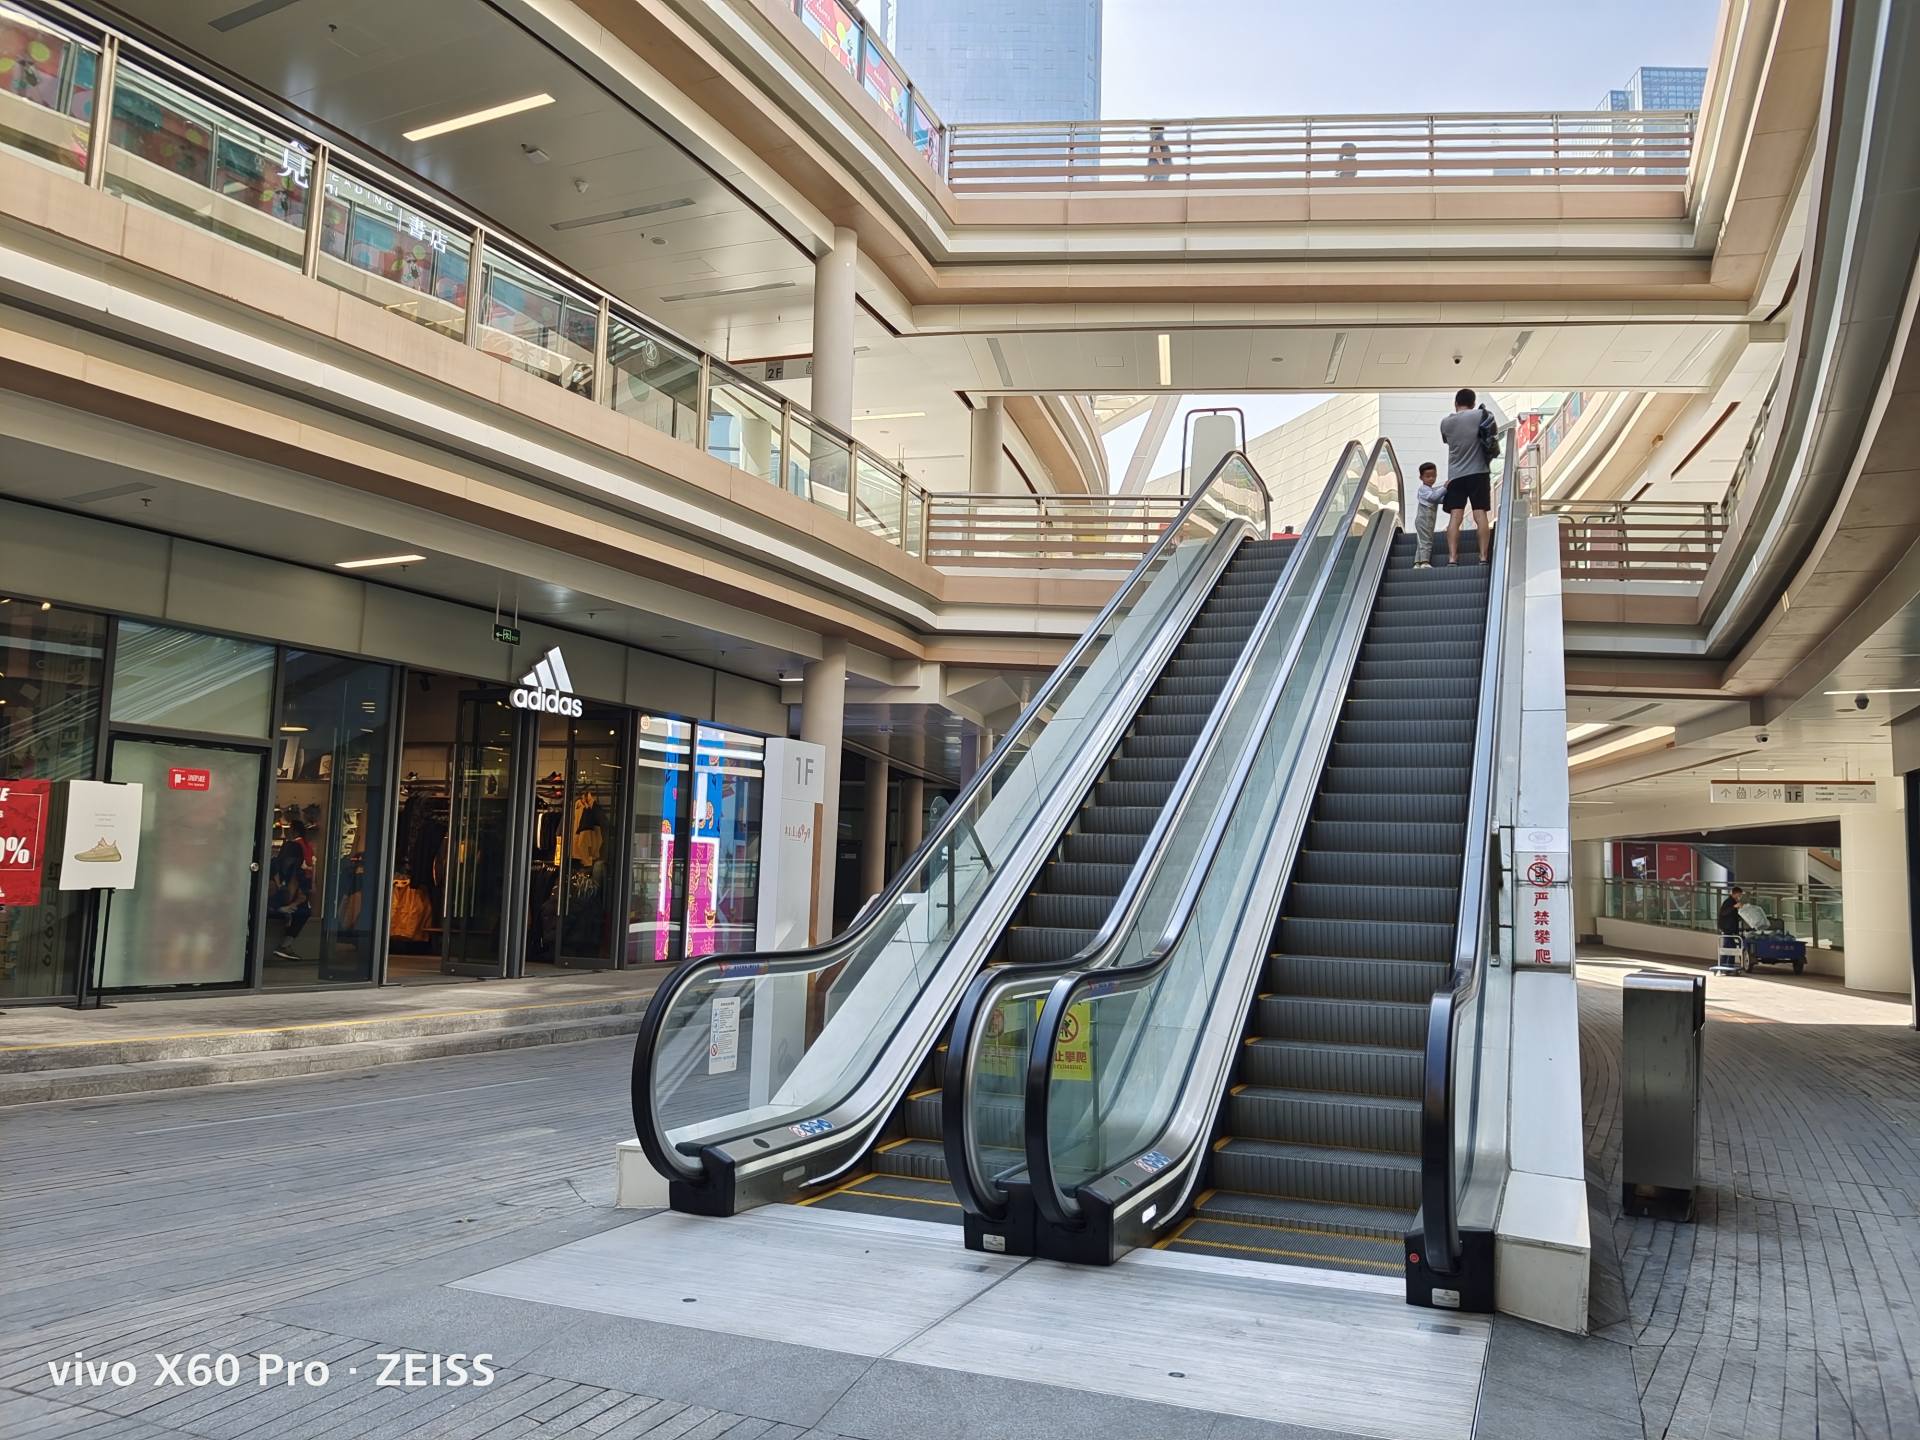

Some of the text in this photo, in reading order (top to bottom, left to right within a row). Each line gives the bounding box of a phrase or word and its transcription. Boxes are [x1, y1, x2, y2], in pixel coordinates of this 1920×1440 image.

[409, 215, 448, 254] 書店
[767, 367, 783, 379] 2F
[511, 686, 583, 718] adidas
[796, 757, 814, 786] 1F
[1787, 791, 1802, 801] 1F
[1534, 891, 1552, 964] 严禁攀爬
